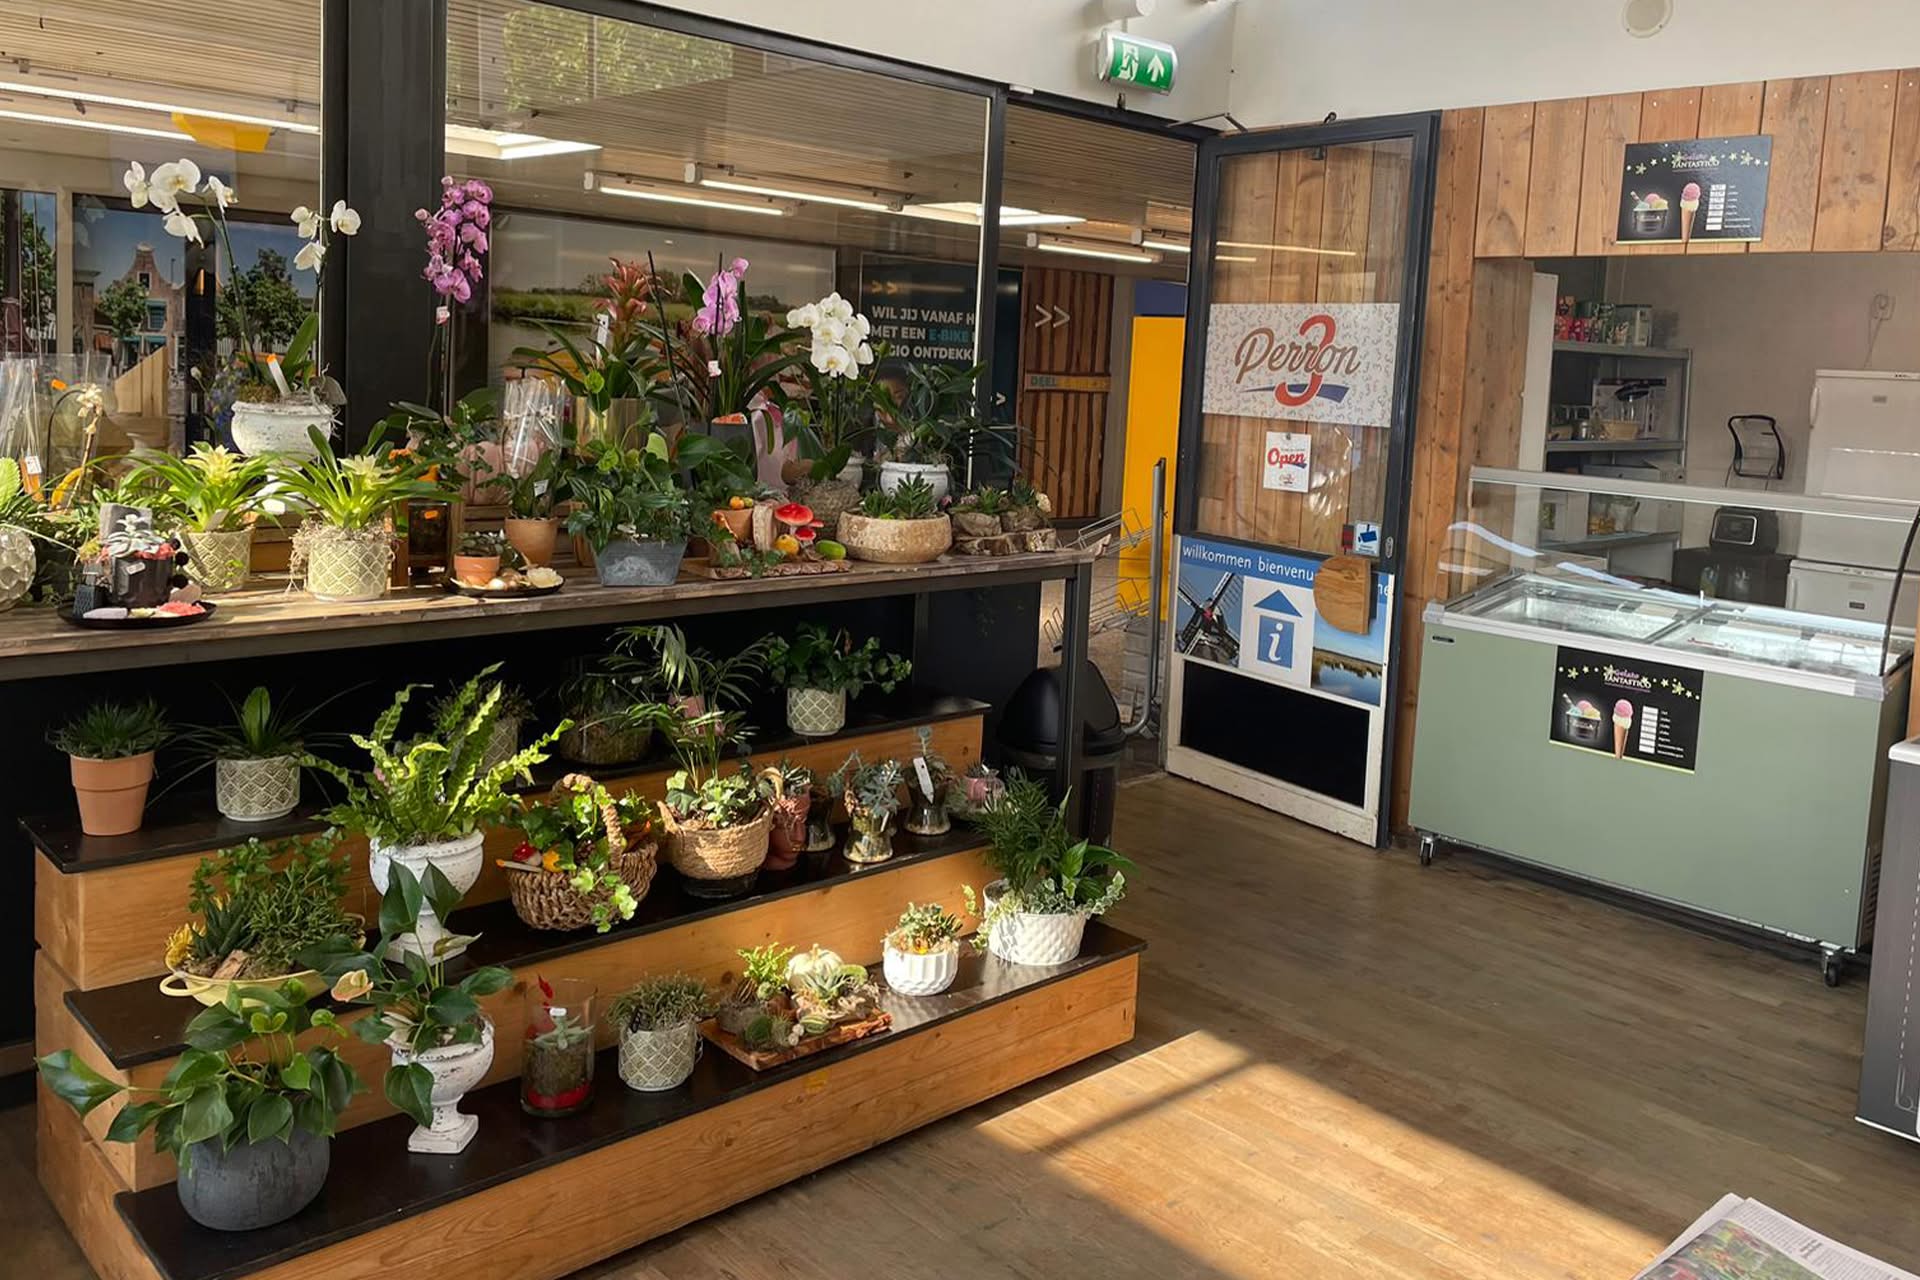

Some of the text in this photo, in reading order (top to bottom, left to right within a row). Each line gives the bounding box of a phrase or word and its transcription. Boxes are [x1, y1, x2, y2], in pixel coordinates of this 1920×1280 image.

[872, 306, 897, 319] WIL
[900, 308, 918, 320] JIJ
[920, 309, 964, 324] VANAF
[871, 325, 898, 338] MET
[901, 326, 926, 340] EEN
[928, 328, 969, 342] E-BIKE
[913, 346, 975, 360] ONTDEKK
[1234, 314, 1361, 407] Perron 3
[1267, 447, 1305, 469] Open
[1182, 545, 1315, 581] willkommen bienvenu
